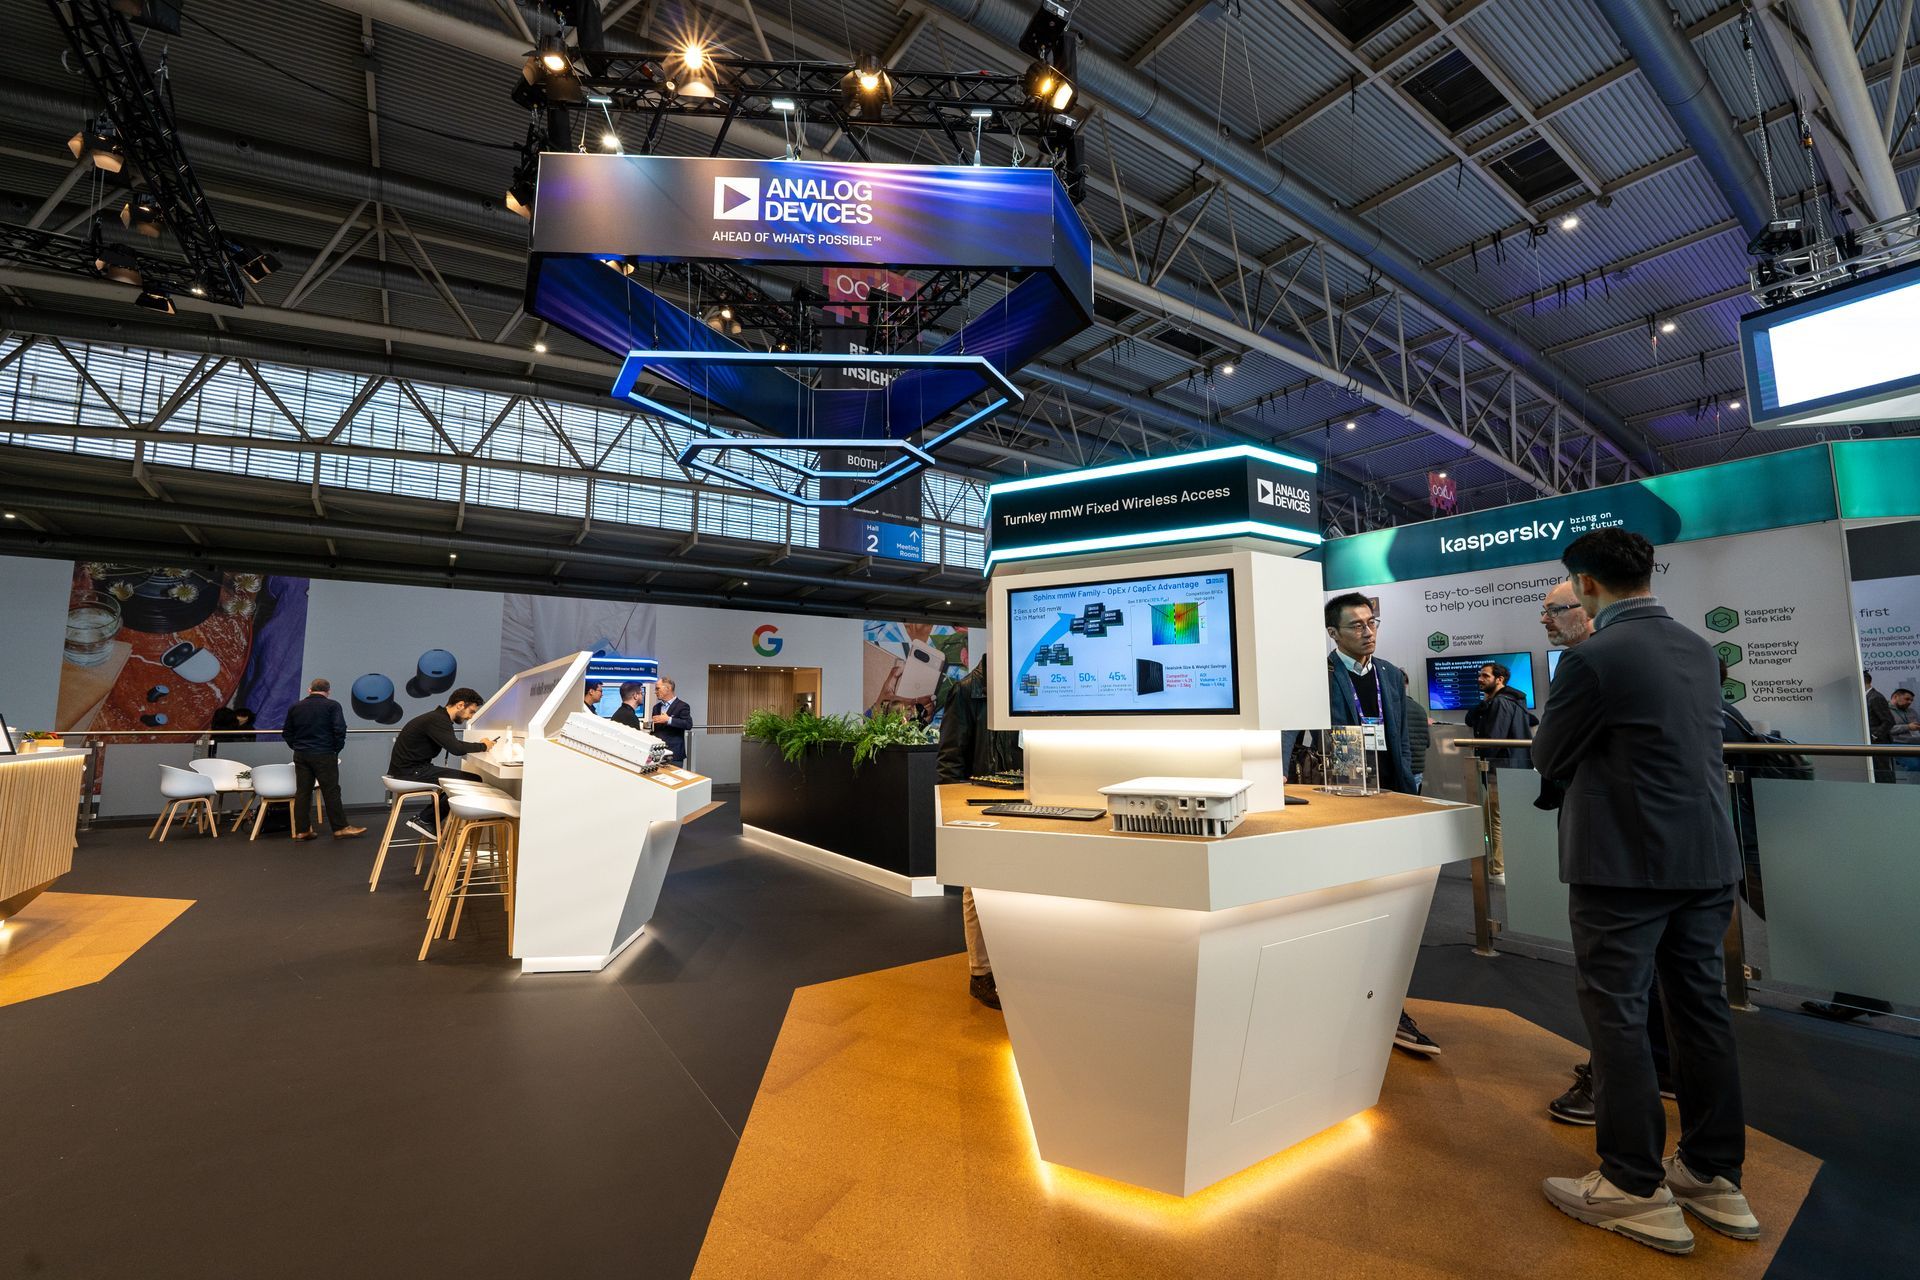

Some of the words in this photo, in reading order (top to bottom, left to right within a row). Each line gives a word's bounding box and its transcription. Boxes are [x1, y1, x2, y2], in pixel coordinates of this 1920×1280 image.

[766, 178, 873, 202] ANALOG
[765, 201, 873, 224] DEVICES
[712, 231, 751, 242] AHEAD
[754, 232, 770, 243] OF
[772, 233, 815, 244] WHAT'S
[848, 455, 878, 470] BOOTH
[1275, 483, 1310, 502] ANALOG
[1004, 512, 1047, 527] Turnkey
[1050, 505, 1084, 520] mmW
[1086, 500, 1119, 515] Fixed
[1122, 493, 1178, 511] Wireless
[1180, 487, 1231, 502] Access
[1275, 497, 1311, 514] DEVICES
[1570, 513, 1597, 525] bring
[1600, 512, 1612, 520] on
[1571, 524, 1587, 533] the
[1590, 518, 1624, 530] future
[1440, 520, 1564, 554] kaspersky
[867, 534, 878, 553] 2
[896, 543, 920, 552] Meeting
[900, 550, 919, 559] Rooms
[1033, 592, 1056, 602] Sphinx
[1078, 589, 1101, 598] Family
[1107, 586, 1126, 595] OpEx
[1132, 584, 1156, 594] CapEx
[1158, 581, 1199, 590] Advantage
[1424, 582, 1494, 600] Easy-to-sell
[1497, 576, 1562, 592] consumer
[1425, 604, 1438, 613] to
[1440, 600, 1465, 616] help
[1467, 598, 1490, 611] you
[1492, 591, 1547, 607] increase
[1744, 606, 1796, 616] Kaspersky
[1860, 608, 1890, 618] first
[1887, 626, 1911, 634] 000
[1452, 633, 1484, 641] Kaspersky
[1747, 640, 1799, 650] Kaspersky
[1748, 648, 1797, 657] Password
[1863, 650, 1919, 659] 7,000,000
[1749, 657, 1792, 665] Manager
[1050, 673, 1067, 683] 25%
[1079, 672, 1096, 682] 50%
[1109, 671, 1127, 681] 45%
[1751, 679, 1803, 687] Kaspersky
